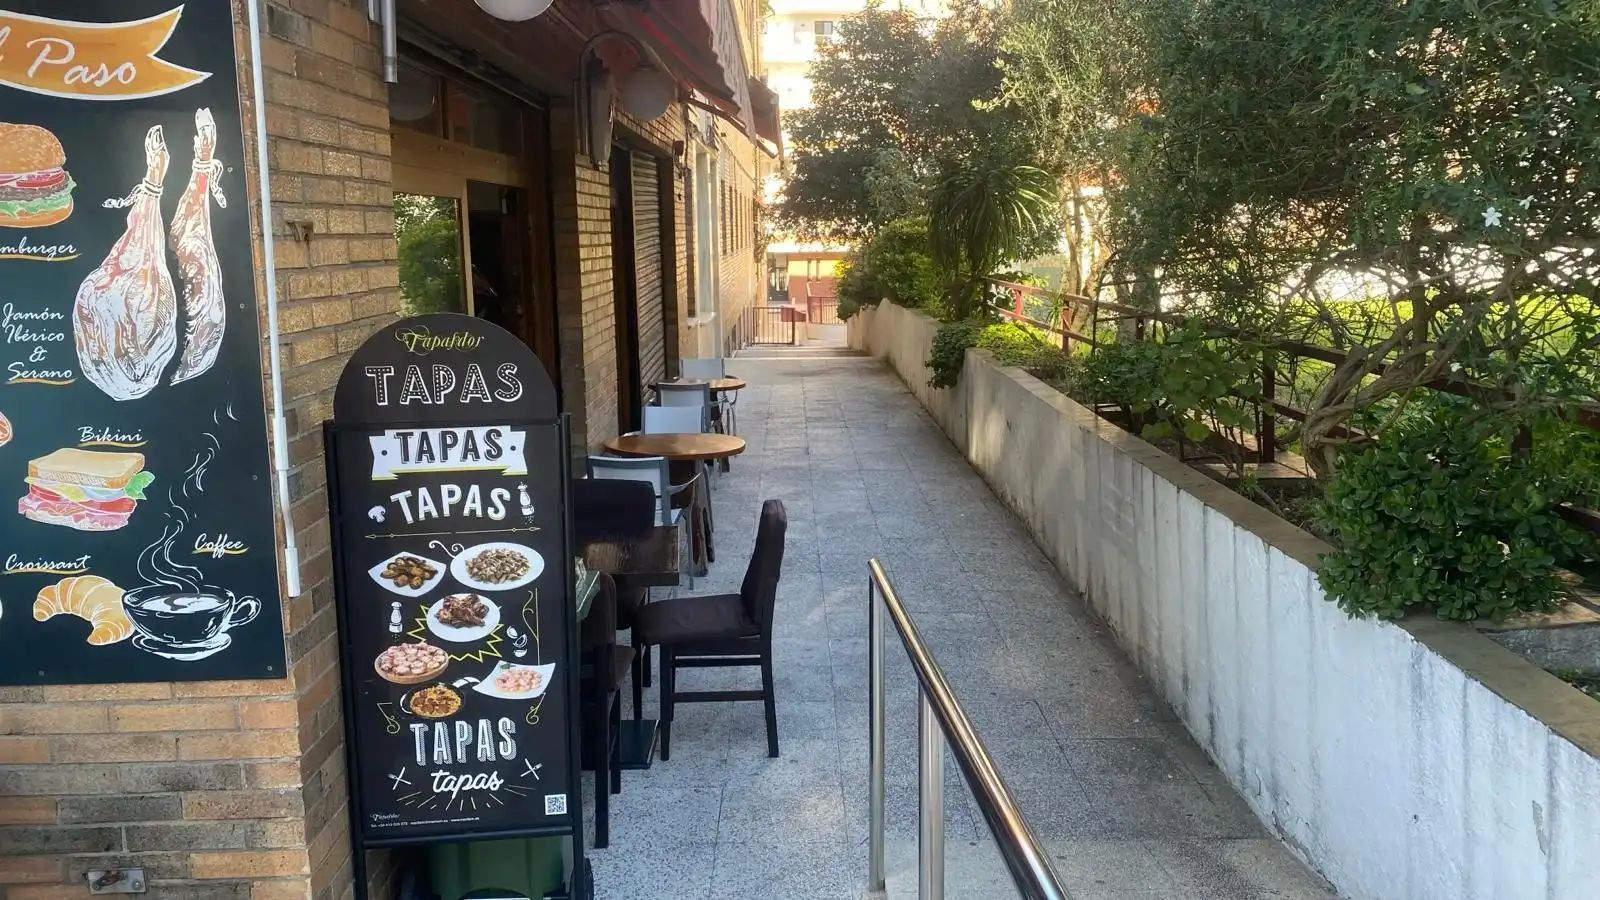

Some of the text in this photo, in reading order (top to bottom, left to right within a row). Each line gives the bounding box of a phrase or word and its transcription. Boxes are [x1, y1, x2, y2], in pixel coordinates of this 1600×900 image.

[26, 37, 137, 87] Paso
[2, 302, 65, 328] Jamón
[5, 324, 65, 344] Ibérico
[29, 345, 47, 363] &
[7, 361, 73, 382] Serano
[365, 363, 523, 406] TAPAS
[78, 426, 143, 443] Bikini
[394, 428, 503, 464] TAPAS
[390, 484, 511, 525] TAPAS
[194, 533, 244, 558] Coffee
[5, 553, 91, 571] Croissant
[409, 716, 517, 766] TAPAS
[430, 769, 504, 799] tapas
